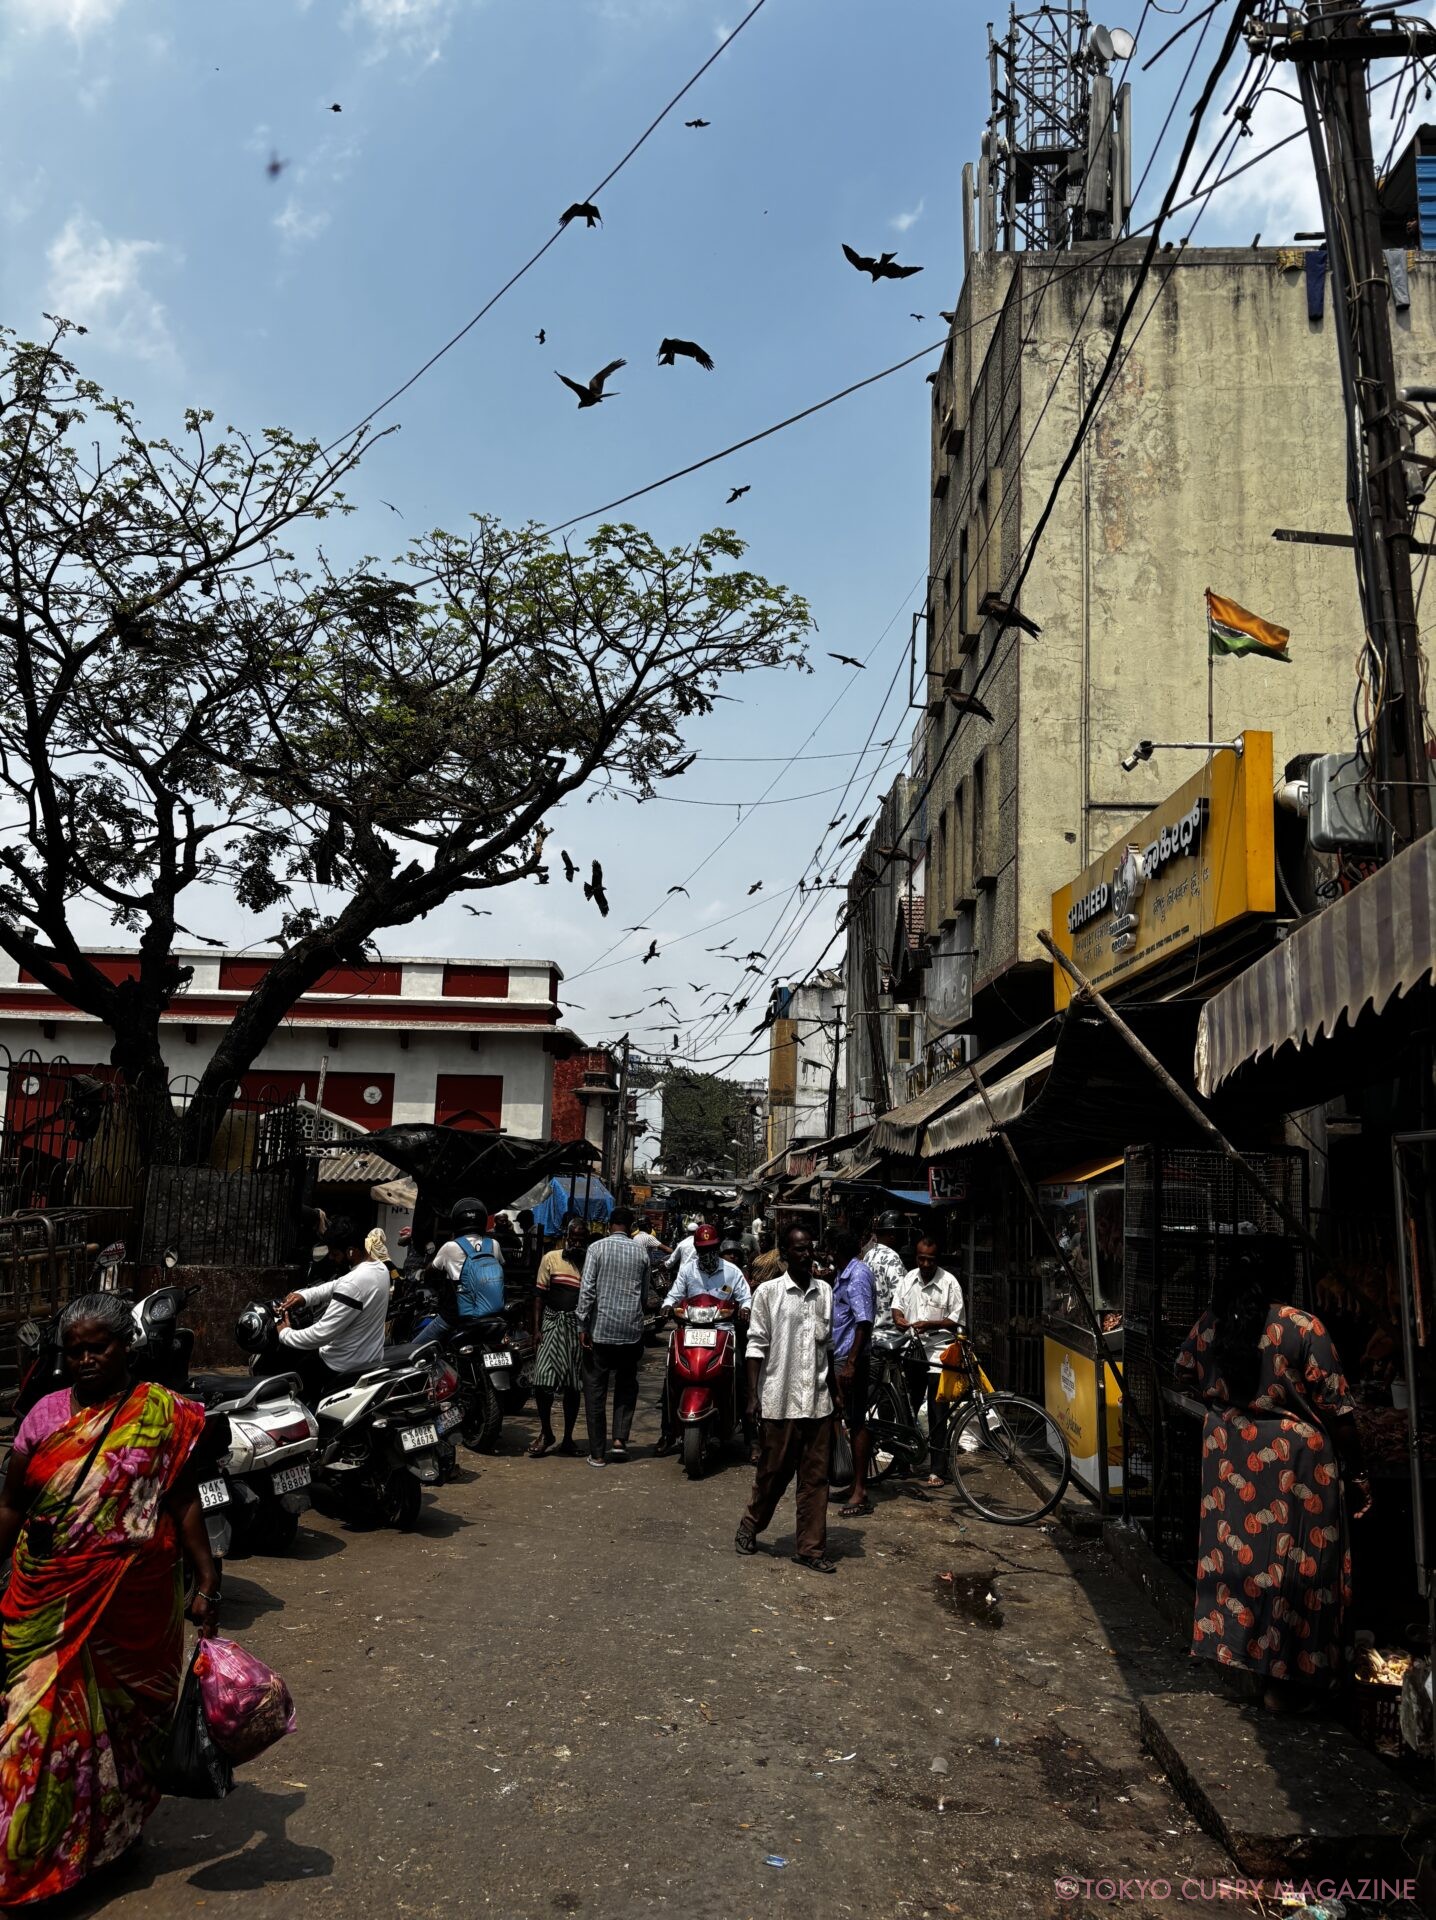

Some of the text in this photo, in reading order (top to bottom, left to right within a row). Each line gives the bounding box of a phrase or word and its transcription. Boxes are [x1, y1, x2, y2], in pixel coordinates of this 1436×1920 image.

[1068, 882, 1108, 932] SHAHEED
[411, 1434, 434, 1447] S4679
[279, 1466, 307, 1482] KA01H
